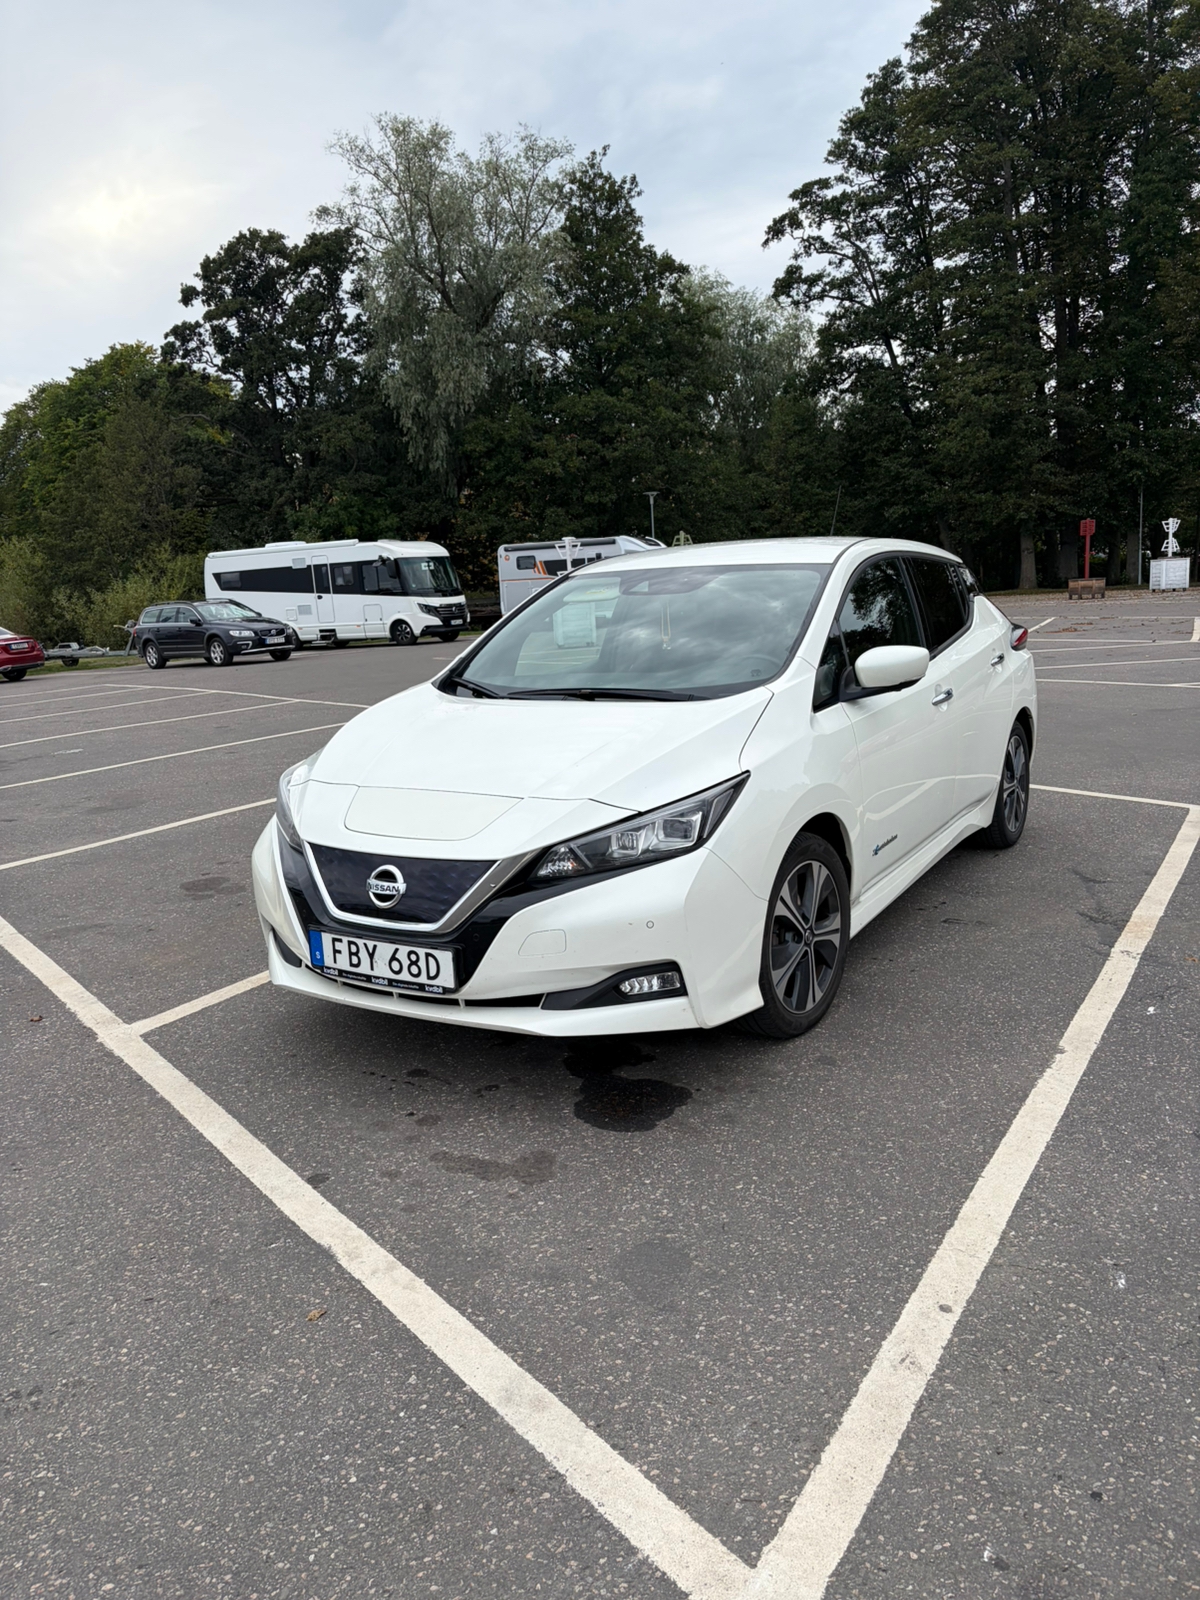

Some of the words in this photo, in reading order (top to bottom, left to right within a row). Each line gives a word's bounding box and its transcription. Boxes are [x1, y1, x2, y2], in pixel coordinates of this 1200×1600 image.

[367, 883, 399, 894] NISSAN
[315, 951, 321, 959] S
[332, 937, 377, 971] FBY
[388, 948, 440, 980] 68D
[371, 977, 388, 986] kvdbil
[425, 985, 443, 993] kvdbil
